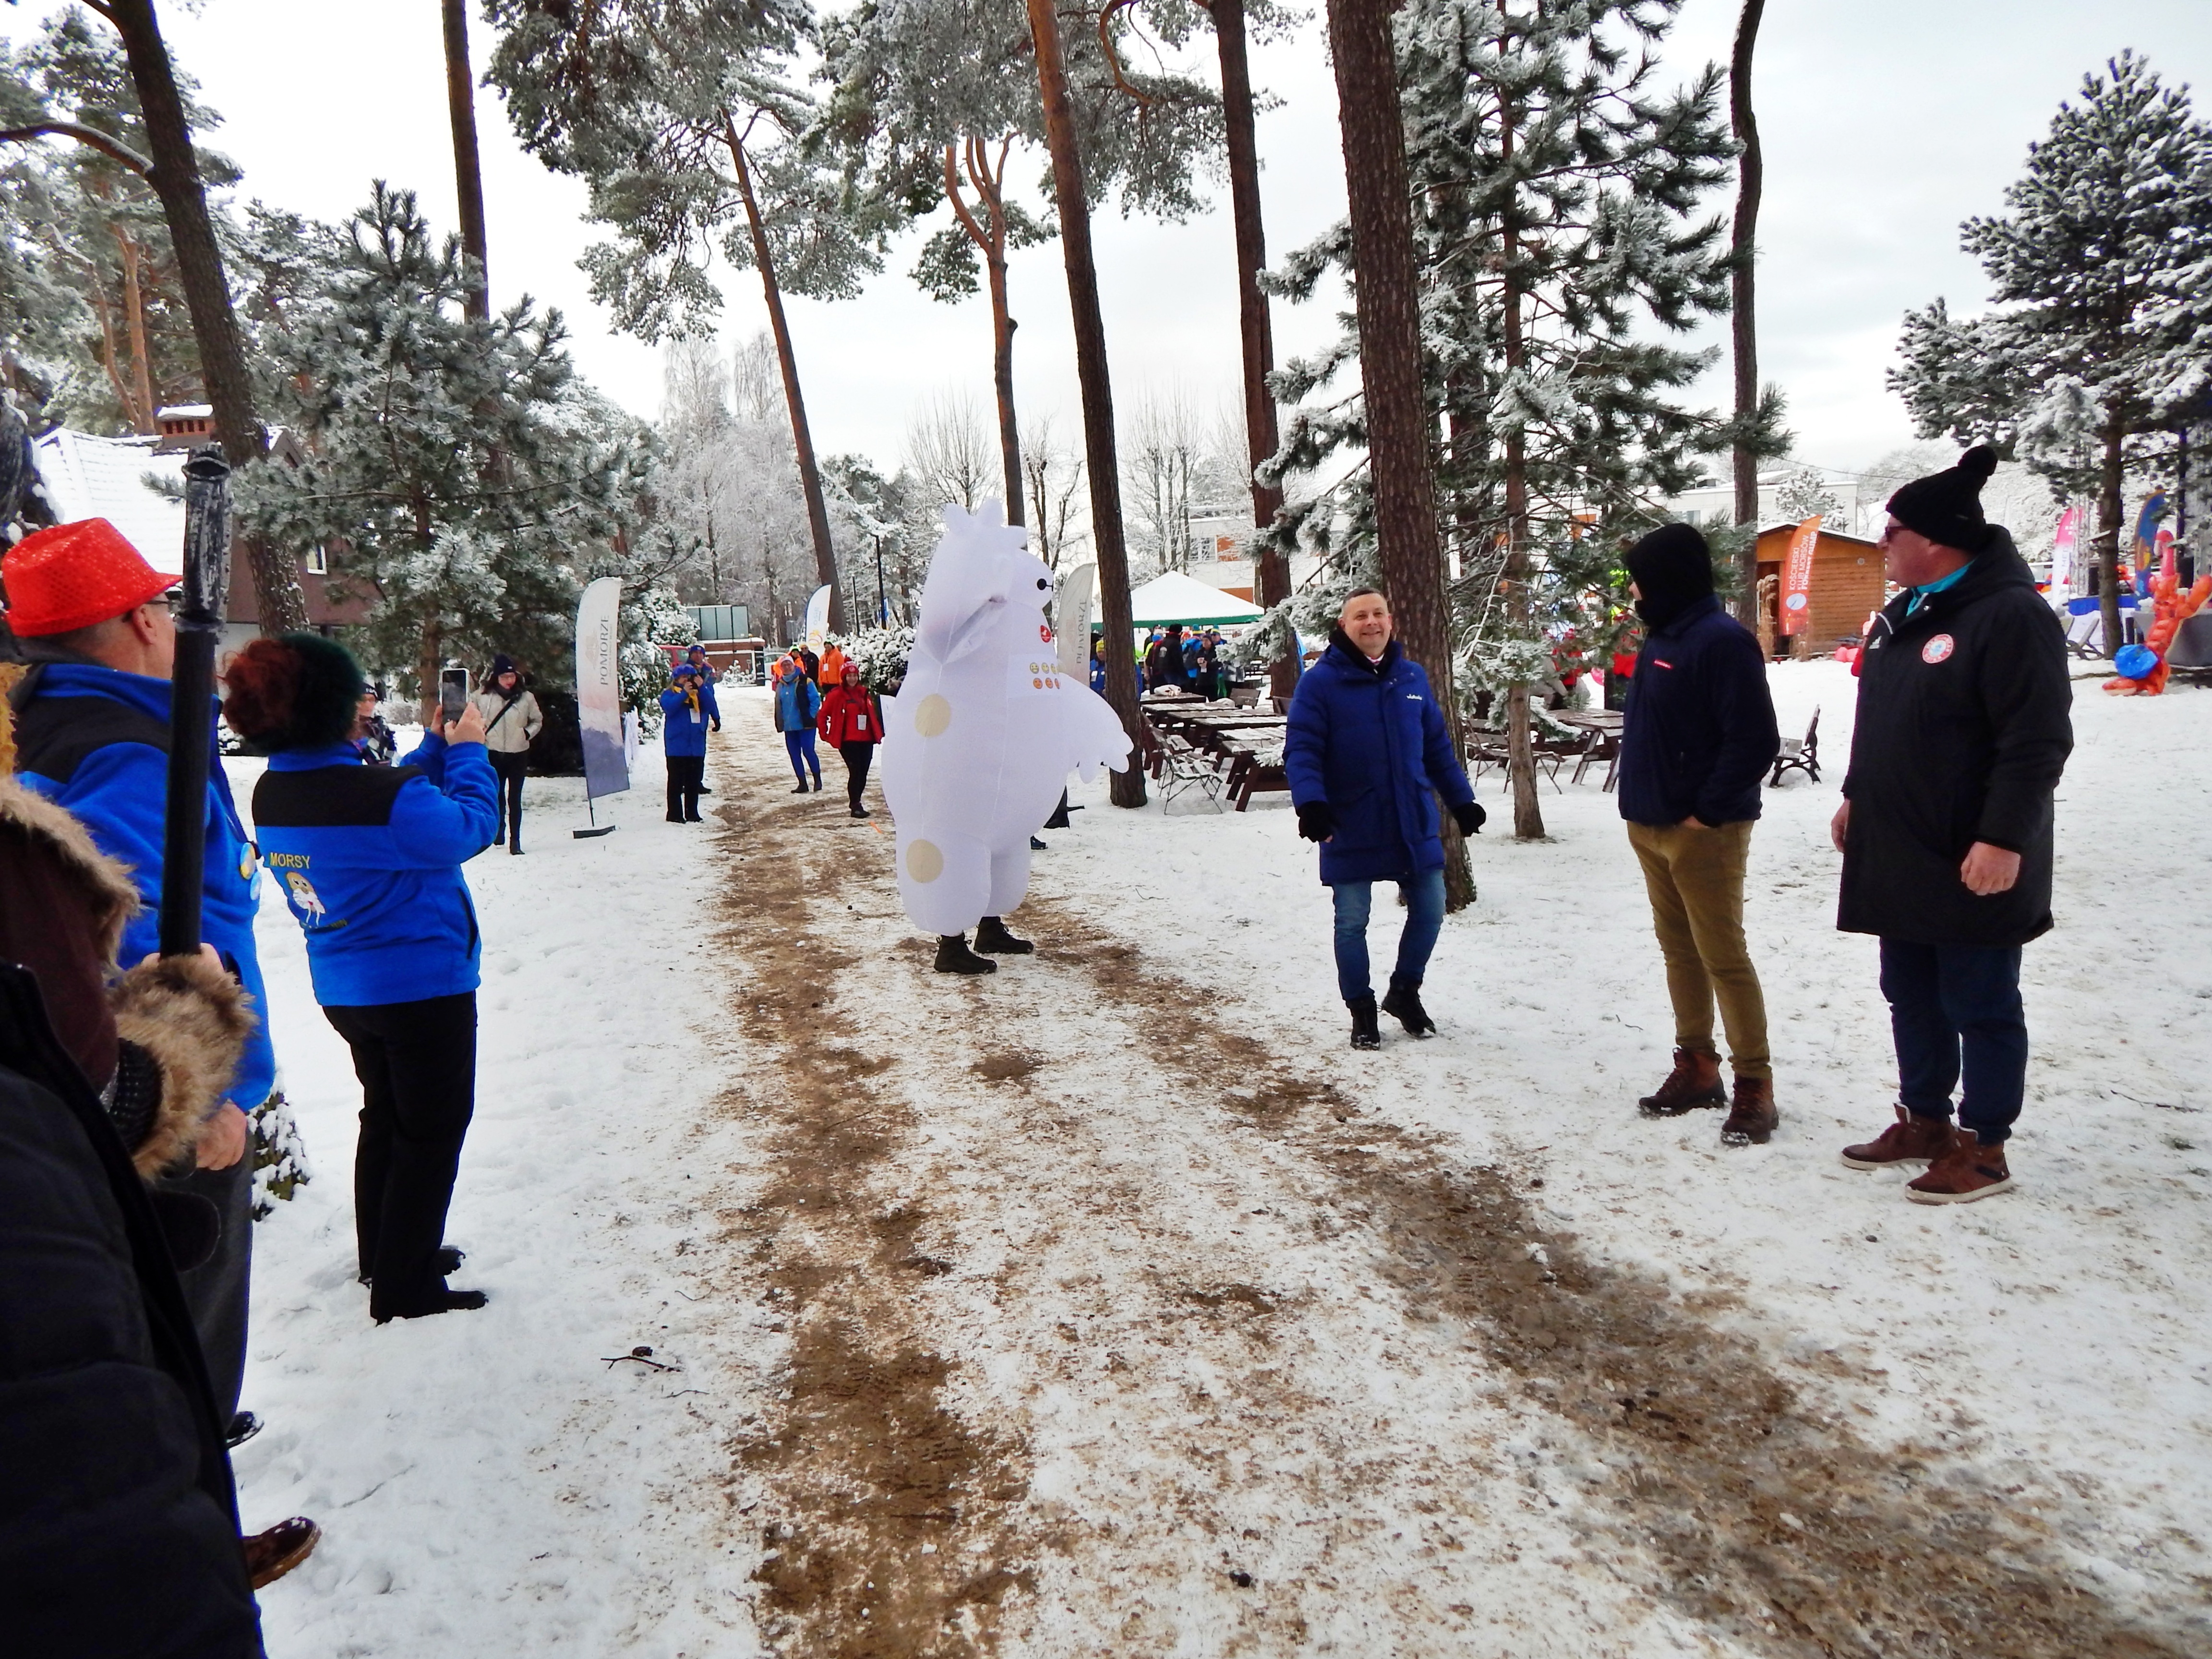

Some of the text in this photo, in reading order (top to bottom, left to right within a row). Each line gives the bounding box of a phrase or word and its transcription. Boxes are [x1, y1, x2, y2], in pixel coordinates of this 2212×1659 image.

[1799, 534, 1809, 571] MORSÓW
[1808, 531, 1817, 555] GUMP
[1789, 547, 1800, 590] KOŚCIERSKI
[600, 615, 609, 685] POMORZE
[270, 852, 310, 869] MORSY
